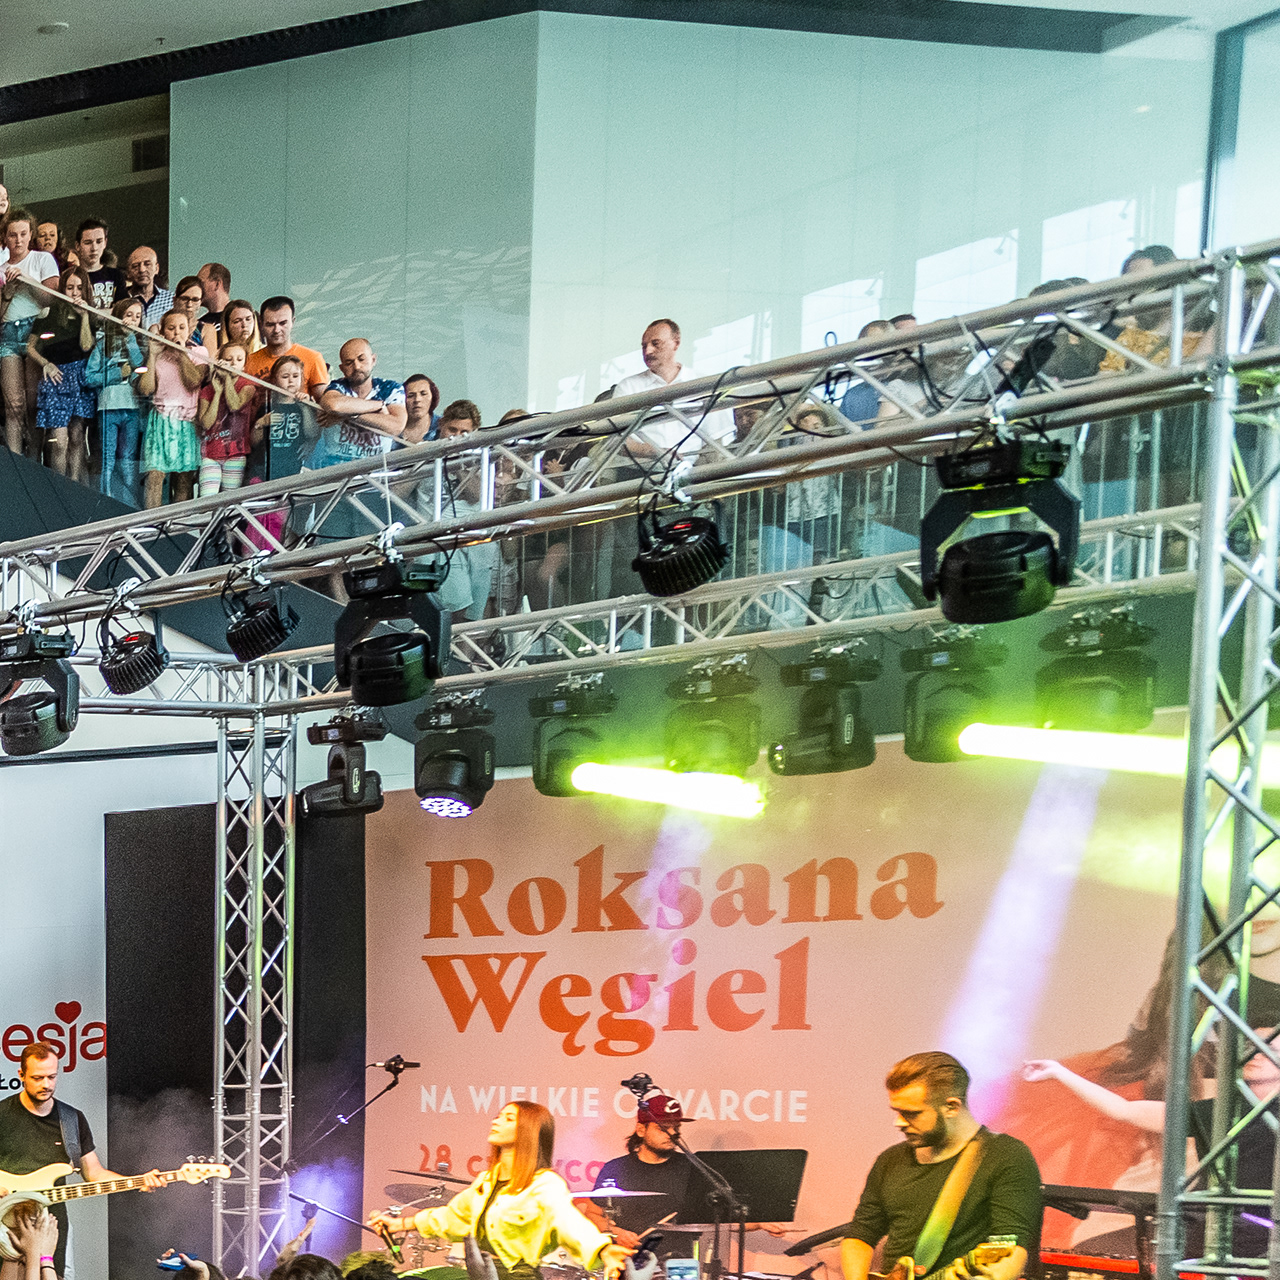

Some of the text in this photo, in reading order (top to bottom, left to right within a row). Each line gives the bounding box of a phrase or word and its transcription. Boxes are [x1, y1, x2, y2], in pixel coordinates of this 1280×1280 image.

[422, 843, 945, 940] Roksana
[421, 936, 813, 1057] Węgiel
[420, 1084, 459, 1115] NA
[613, 1088, 808, 1124] OWARCIE
[419, 1143, 453, 1173] 28
